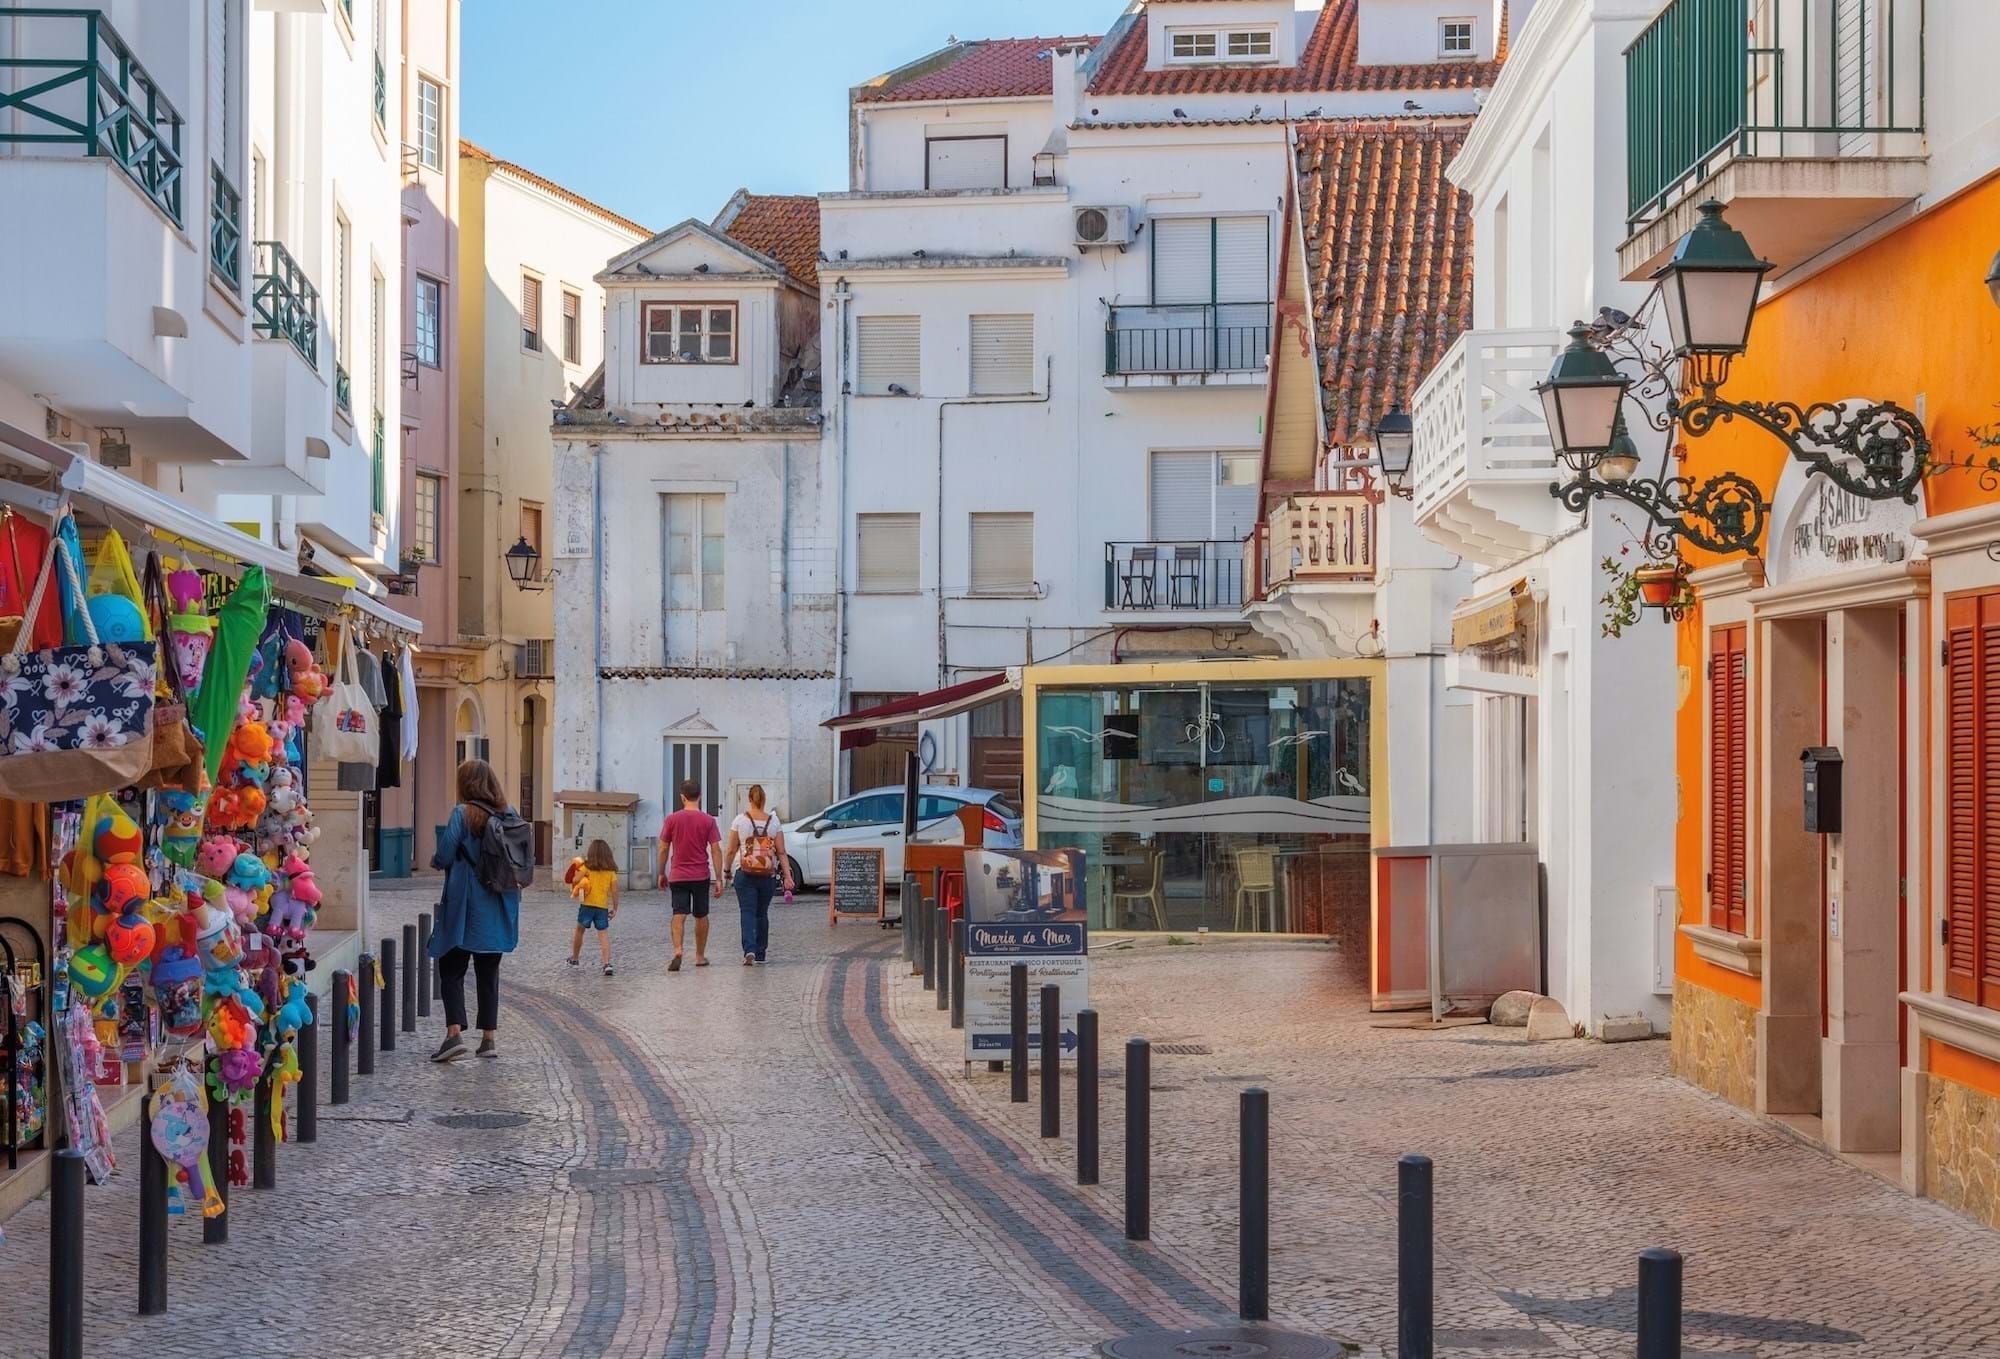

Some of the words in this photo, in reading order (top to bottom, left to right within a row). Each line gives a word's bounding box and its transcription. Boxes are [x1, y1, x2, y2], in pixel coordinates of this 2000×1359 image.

[975, 928, 1017, 947] Maria
[1023, 931, 1037, 944] do
[1042, 928, 1073, 946] Mar
